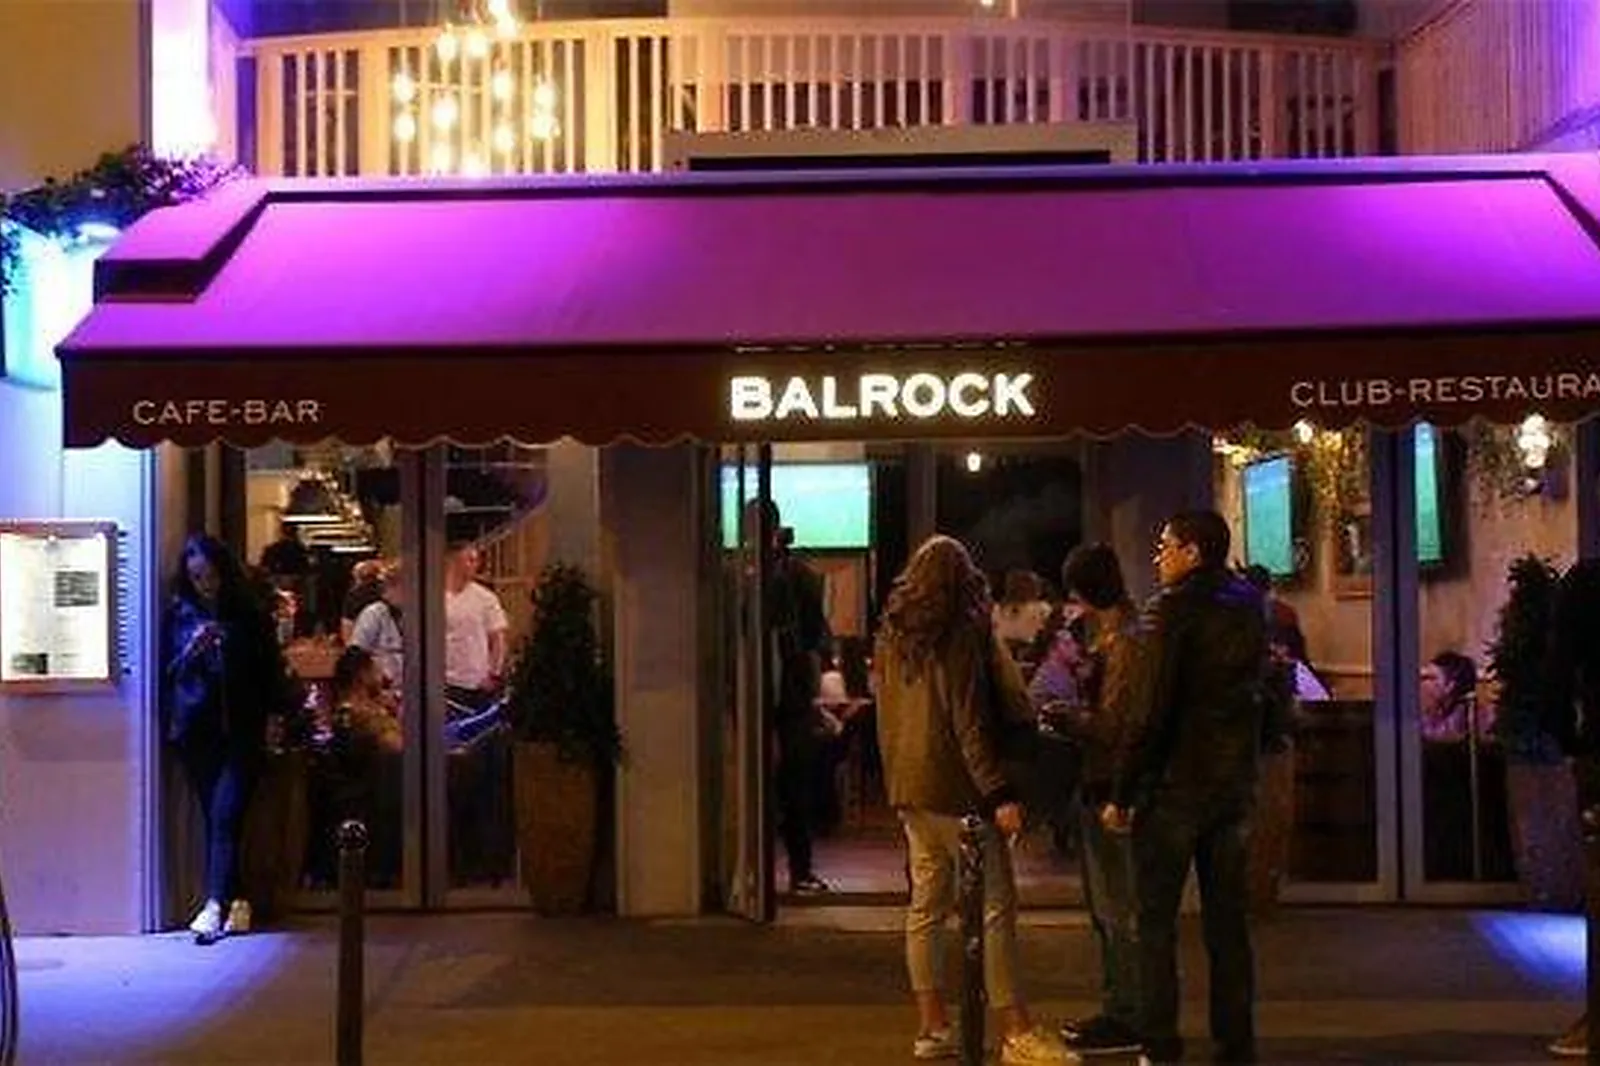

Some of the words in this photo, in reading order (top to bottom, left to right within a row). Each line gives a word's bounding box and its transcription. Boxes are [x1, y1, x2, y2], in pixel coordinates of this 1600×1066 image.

[730, 372, 1036, 419] BALROCK
[1290, 373, 1600, 406] CLUB-RESTAURA
[132, 399, 320, 426] CAFE-BAR
